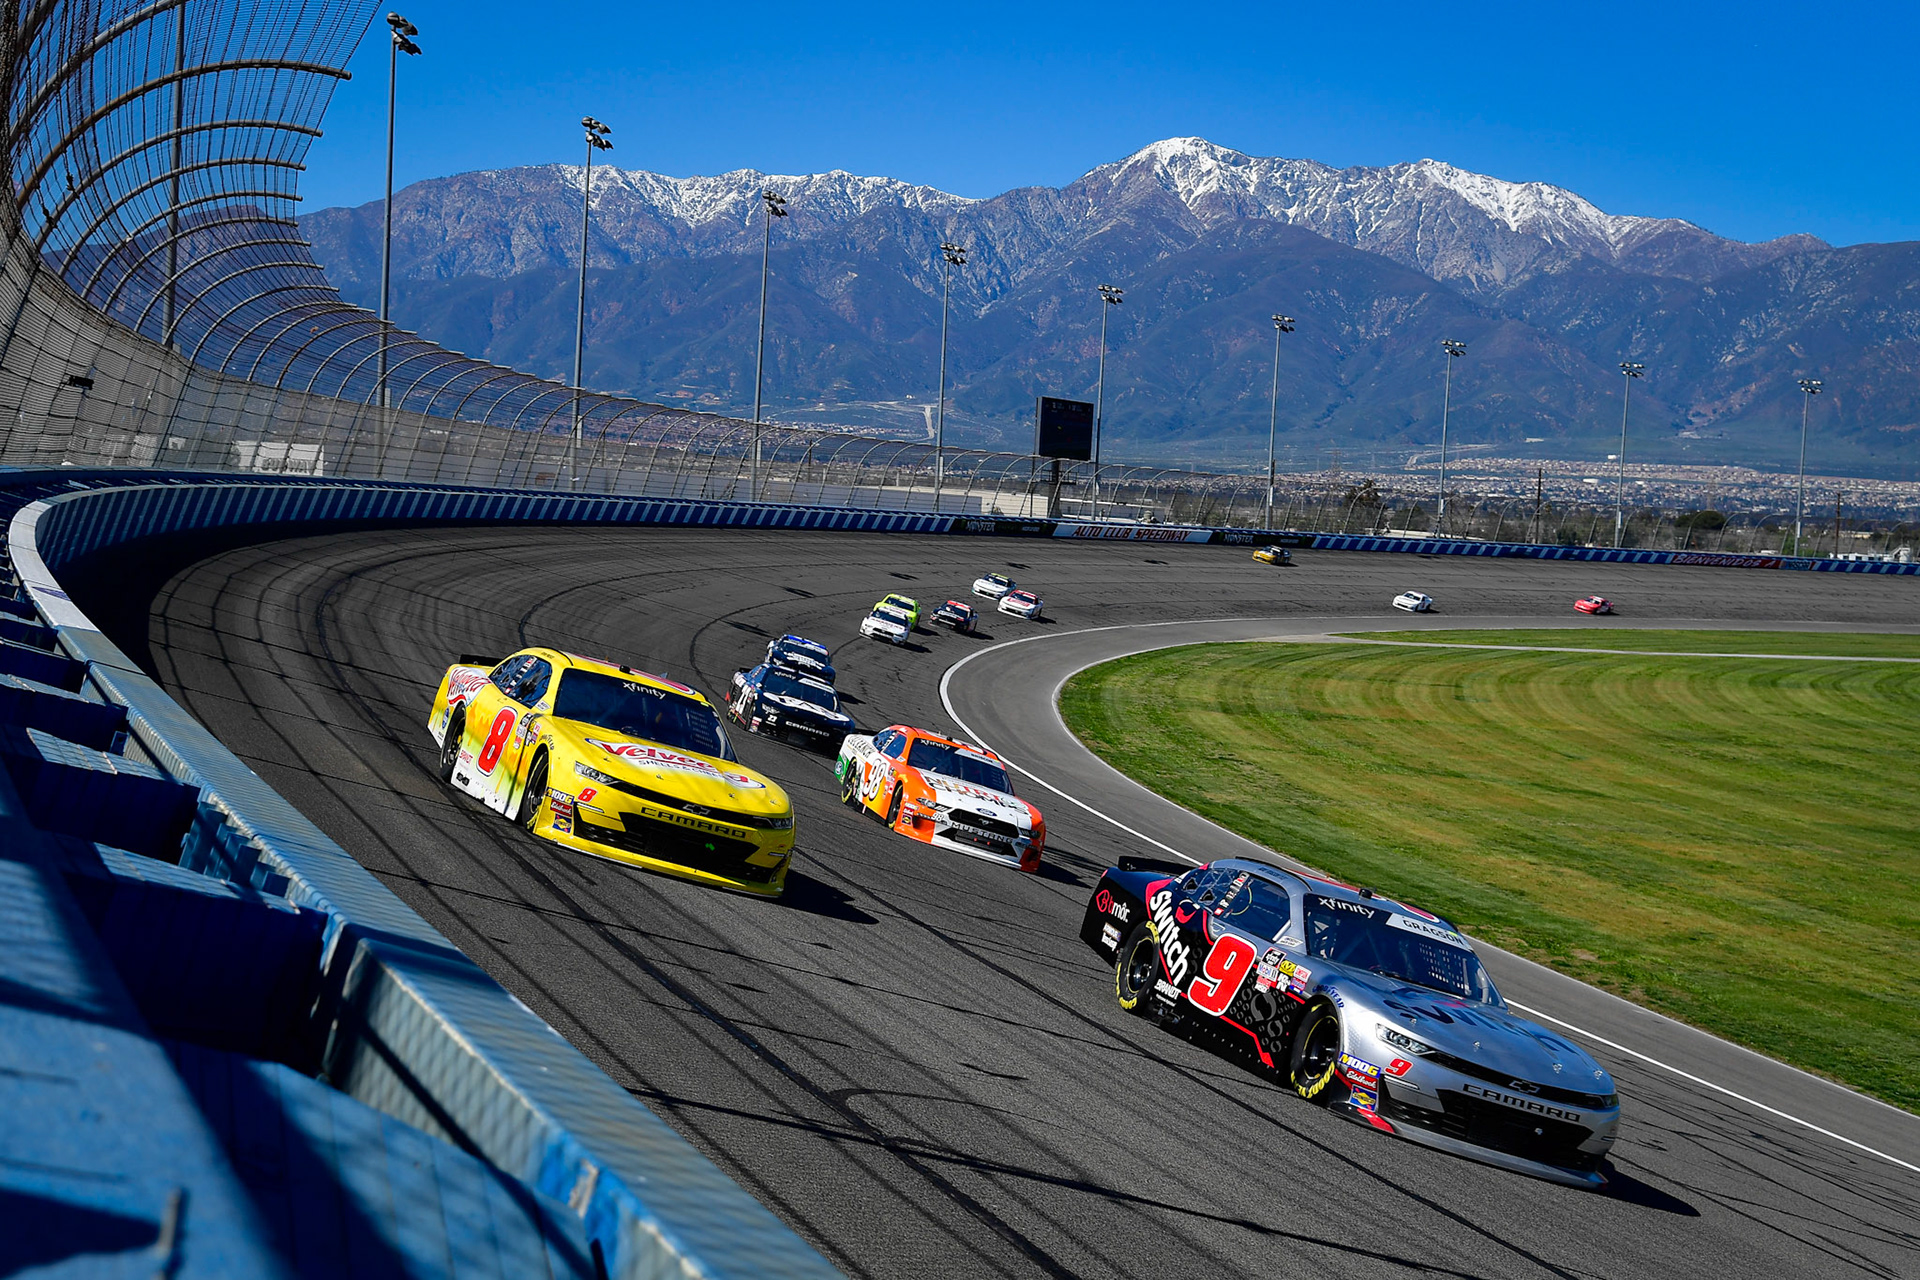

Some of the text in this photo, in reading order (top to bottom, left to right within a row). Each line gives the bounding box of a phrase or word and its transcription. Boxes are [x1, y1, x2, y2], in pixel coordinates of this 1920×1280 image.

[1072, 526, 1191, 541] AUTO CLUB SPEEDWAY
[1672, 553, 1760, 567] BIENVENIDOS
[623, 682, 667, 700] xfinity
[476, 706, 518, 777] 8
[920, 739, 951, 751] xfinity
[862, 759, 887, 801] 98
[577, 787, 598, 802] 8
[641, 807, 746, 839] CAMARO
[931, 812, 944, 821] 98
[1317, 897, 1375, 919] xfinity
[1403, 920, 1465, 946] GRAGSON
[1187, 932, 1258, 1017] 9
[1154, 979, 1182, 1000] BRANDT
[1311, 984, 1345, 1009] GOODYEAR
[1339, 1053, 1379, 1077] MOOG
[1384, 1058, 1413, 1077] 9
[1346, 1070, 1376, 1089] Edelbrock
[1462, 1083, 1581, 1122] CAMARO
